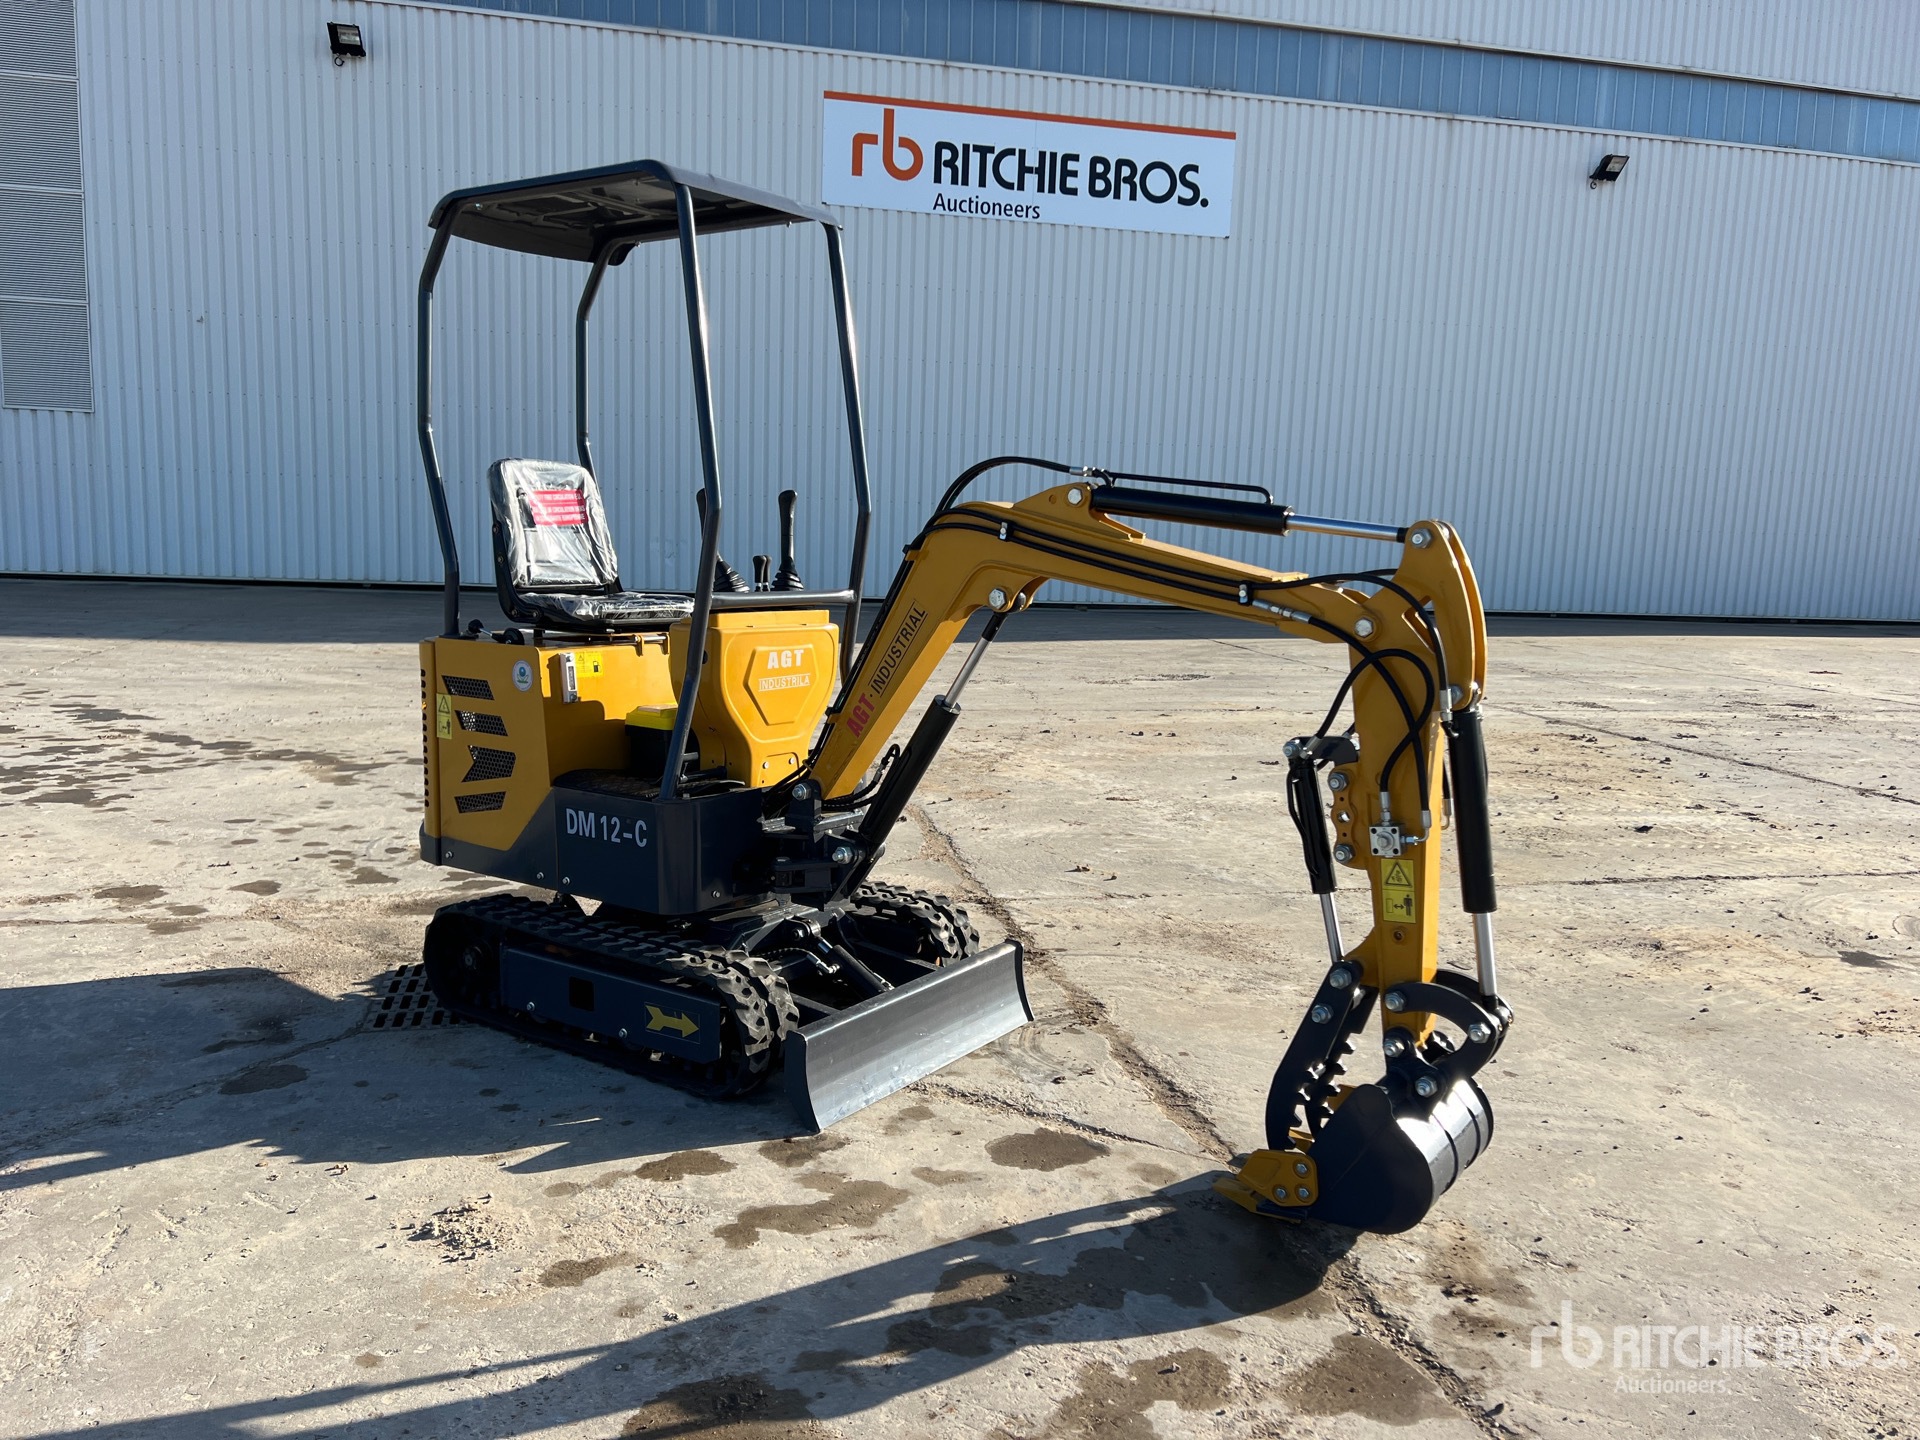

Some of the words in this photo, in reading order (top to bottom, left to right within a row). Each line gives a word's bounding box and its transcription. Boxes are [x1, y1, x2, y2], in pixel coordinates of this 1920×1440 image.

[851, 108, 924, 182] rb
[933, 141, 1080, 196] RITCHIE
[1088, 156, 1209, 208] BROS.
[932, 193, 1041, 220] Auctioneers
[767, 649, 804, 669] AGT
[846, 692, 875, 738] AGT
[870, 607, 926, 695] INDUSTRIAL
[758, 674, 811, 692] INDUSTRILA
[566, 808, 595, 838] DM
[600, 815, 647, 848] 12-C
